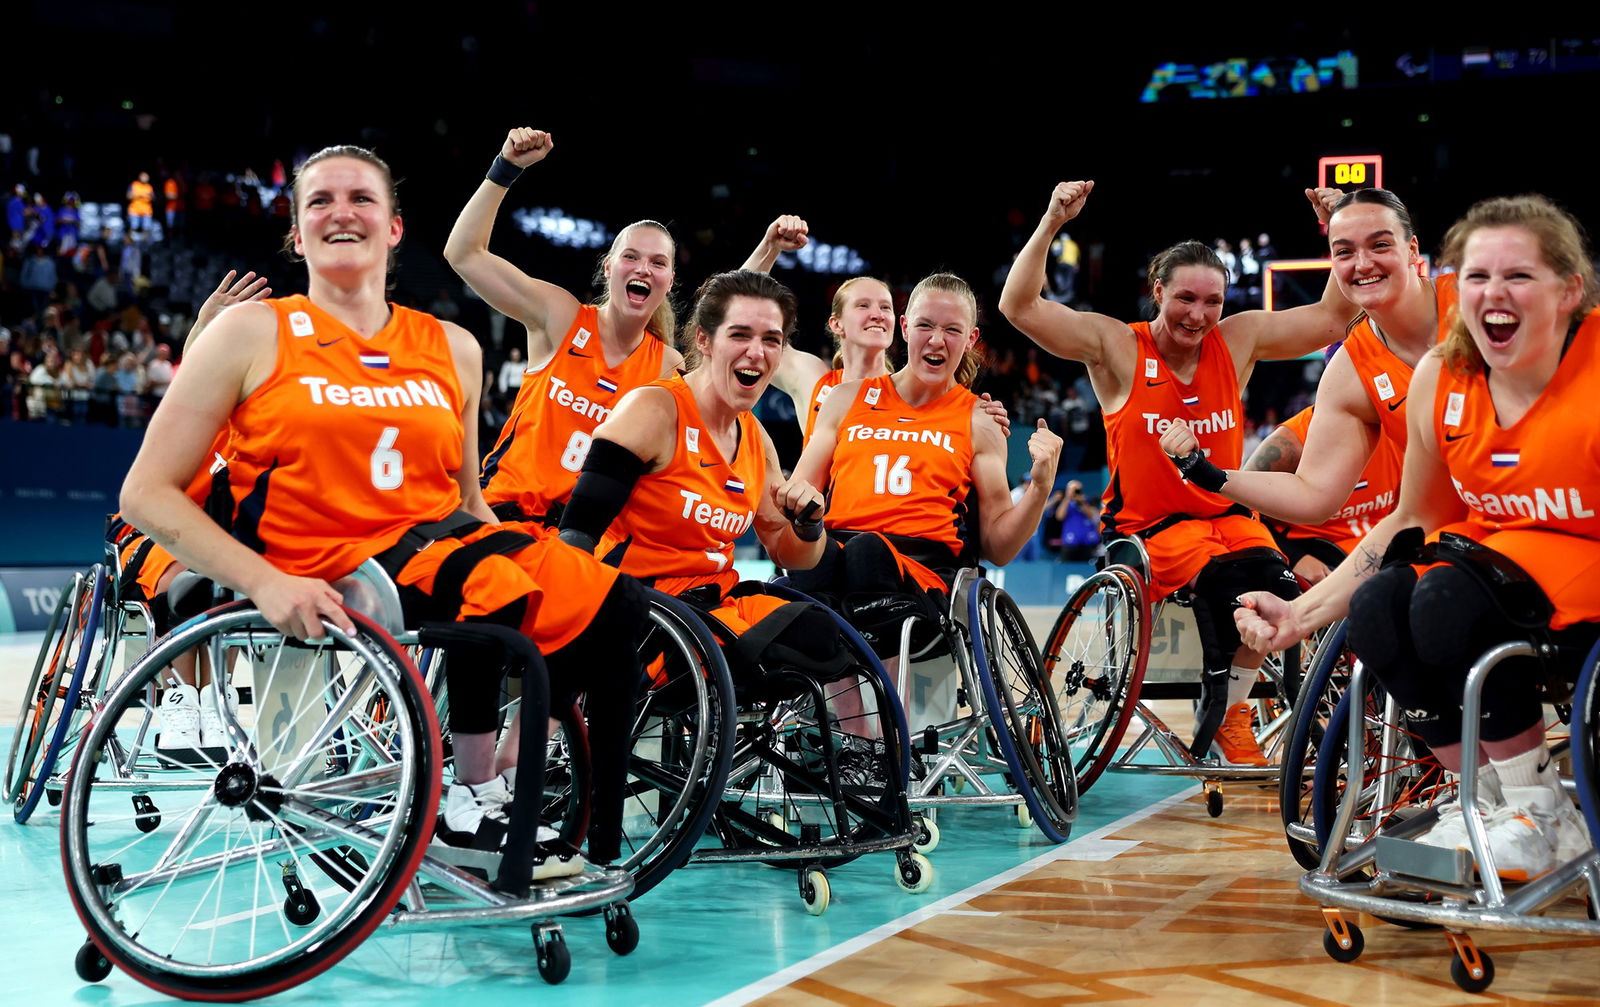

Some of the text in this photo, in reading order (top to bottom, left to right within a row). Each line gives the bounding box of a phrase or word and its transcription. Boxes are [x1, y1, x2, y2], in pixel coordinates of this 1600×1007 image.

[300, 376, 451, 410] TeamNL
[847, 424, 955, 453] TeamNL
[1142, 409, 1236, 434] TemNL
[371, 427, 404, 490] 6
[560, 430, 593, 472] 8
[873, 454, 912, 496] 16
[1329, 490, 1394, 520] amNL
